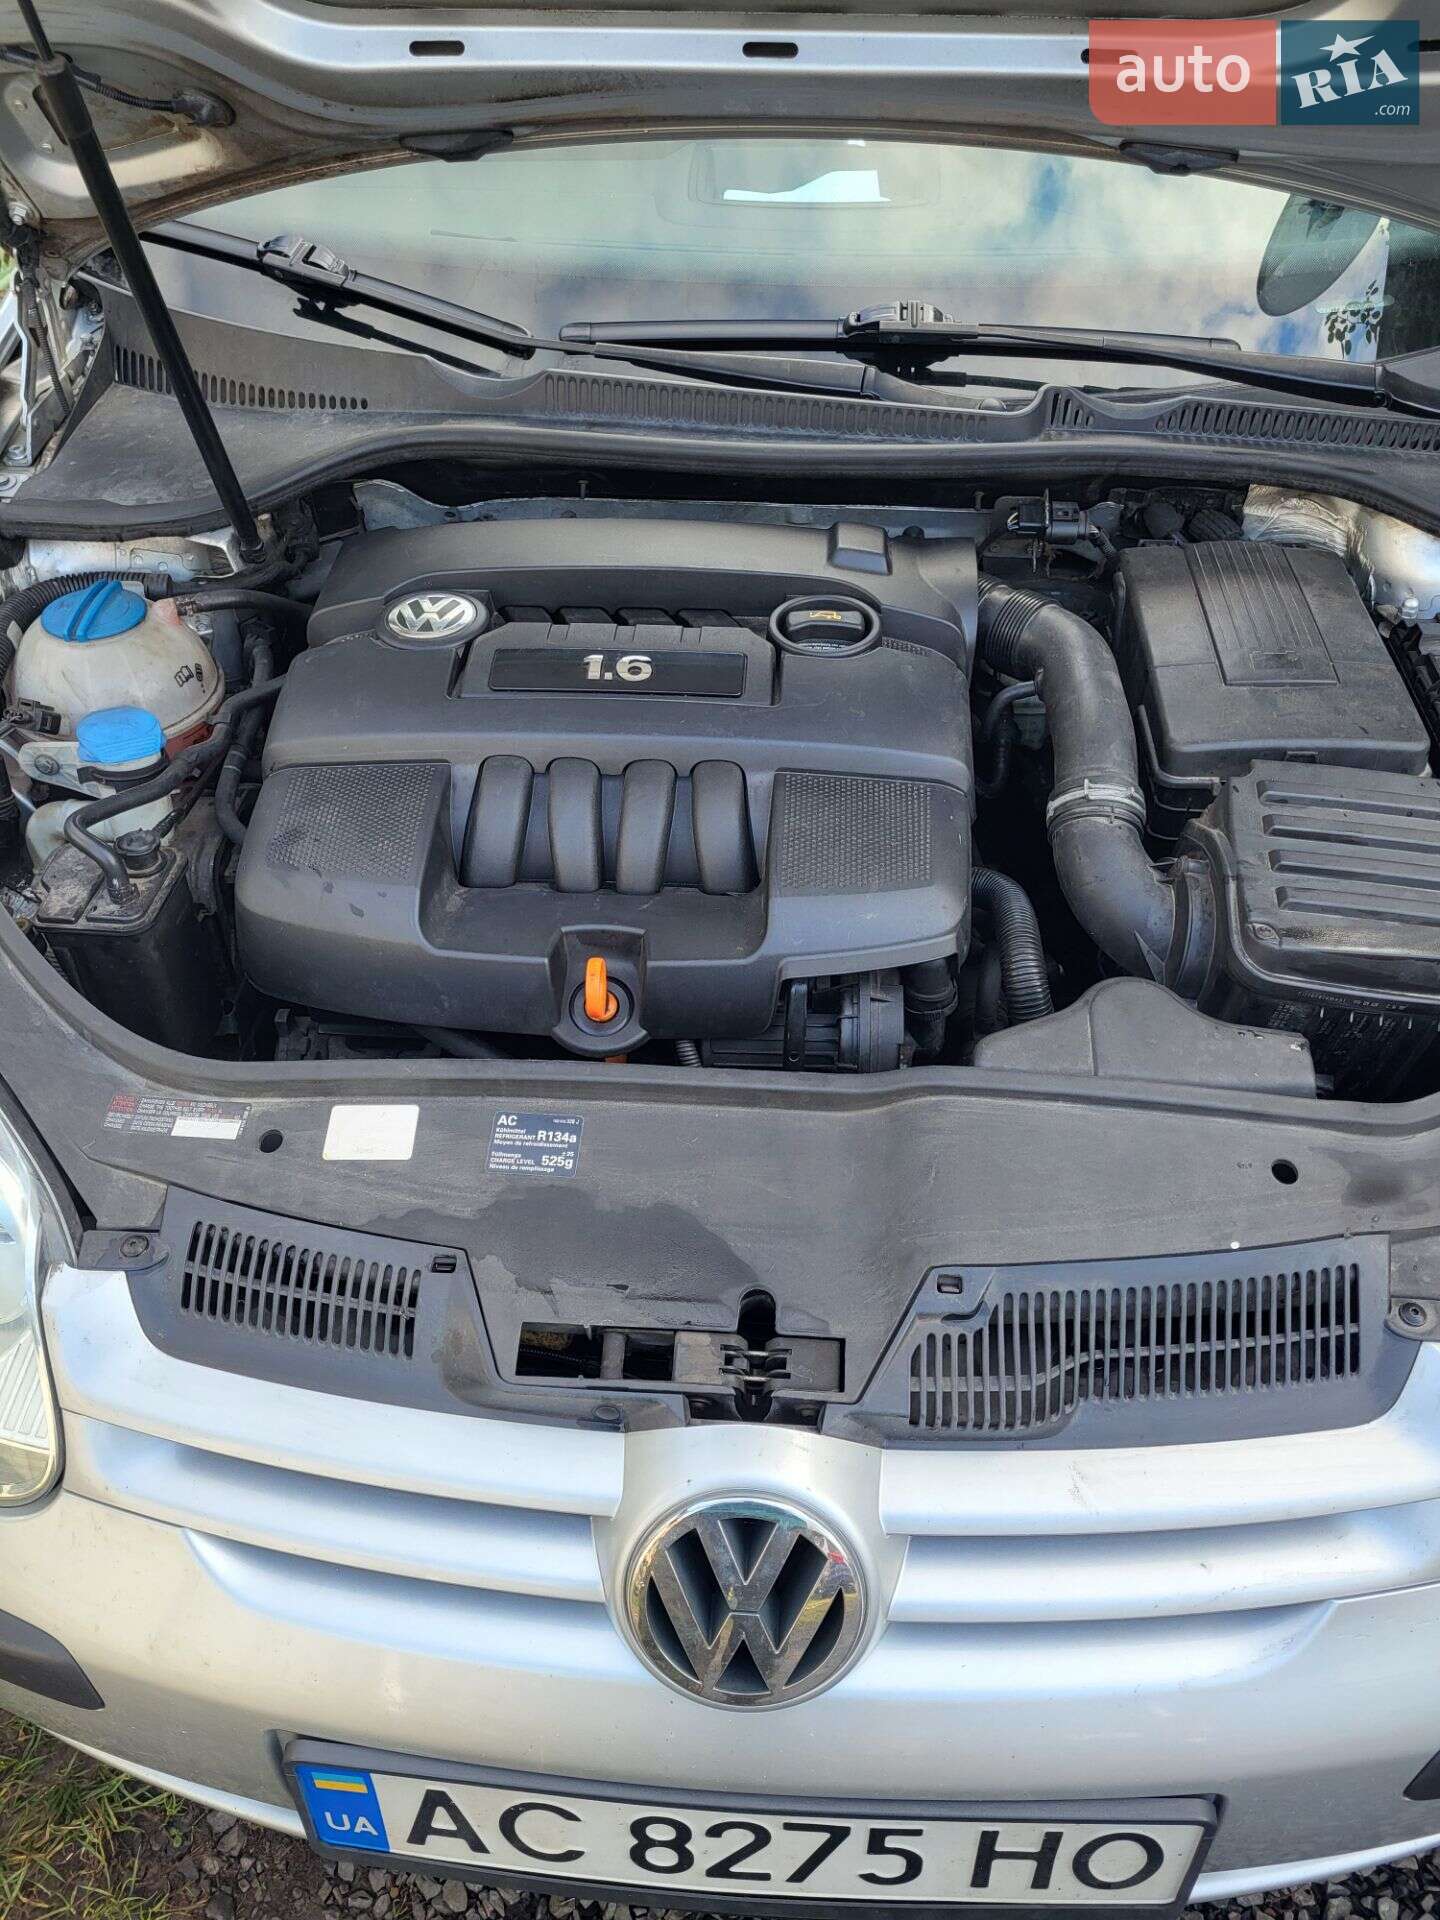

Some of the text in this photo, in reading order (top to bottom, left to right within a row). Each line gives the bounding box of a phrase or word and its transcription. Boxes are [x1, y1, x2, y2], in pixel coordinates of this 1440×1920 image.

[583, 654, 653, 682] 1.6
[497, 1114, 518, 1126] AC
[537, 1130, 577, 1143] R134a
[542, 1155, 574, 1169] 525g
[324, 1811, 378, 1836] UA
[406, 1789, 1165, 1890] AC 8275 HO
